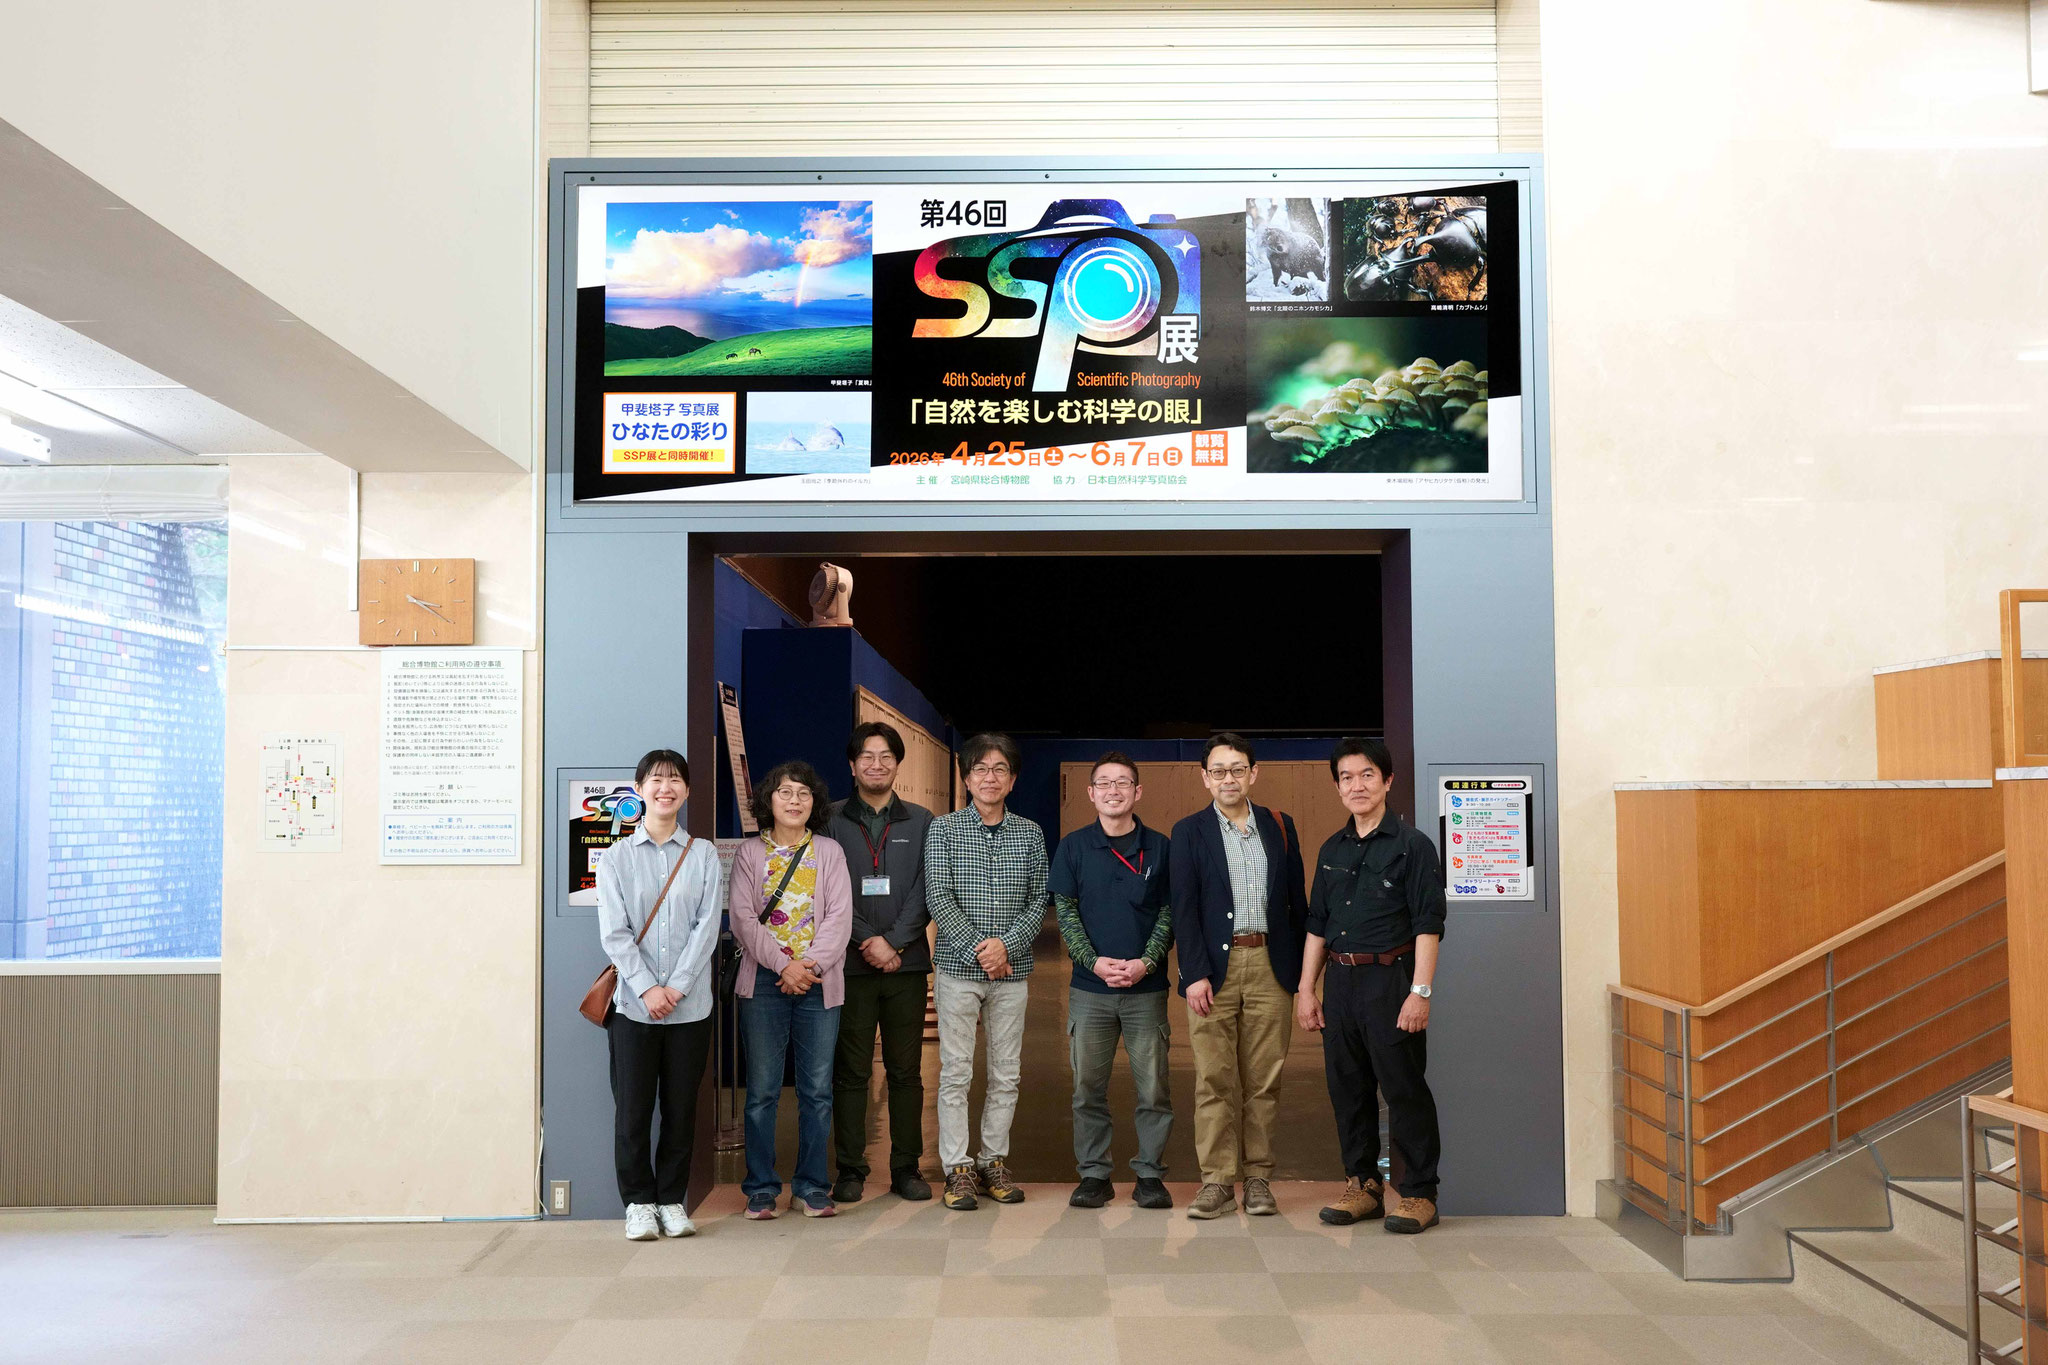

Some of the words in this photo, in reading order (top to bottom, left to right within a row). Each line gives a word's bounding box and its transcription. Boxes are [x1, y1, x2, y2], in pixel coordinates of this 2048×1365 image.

[920, 199, 1007, 228] 第46回
[1157, 314, 1200, 365] 展
[942, 372, 969, 387] 46th
[971, 372, 1012, 390] Society
[1014, 372, 1026, 387] of
[1077, 372, 1129, 387] Scientific
[1131, 372, 1202, 390] Photography
[621, 403, 676, 417] 甲斐塔子
[679, 403, 720, 417] 写真展
[910, 398, 1202, 425] 「自然を楽しむ科学の眼」
[612, 422, 728, 441] ひなたの彩り
[1195, 434, 1225, 447] 観覧
[889, 452, 945, 466] 2026年
[1195, 449, 1225, 464] 無料
[1087, 475, 1188, 485] 日本自然科学写真協会
